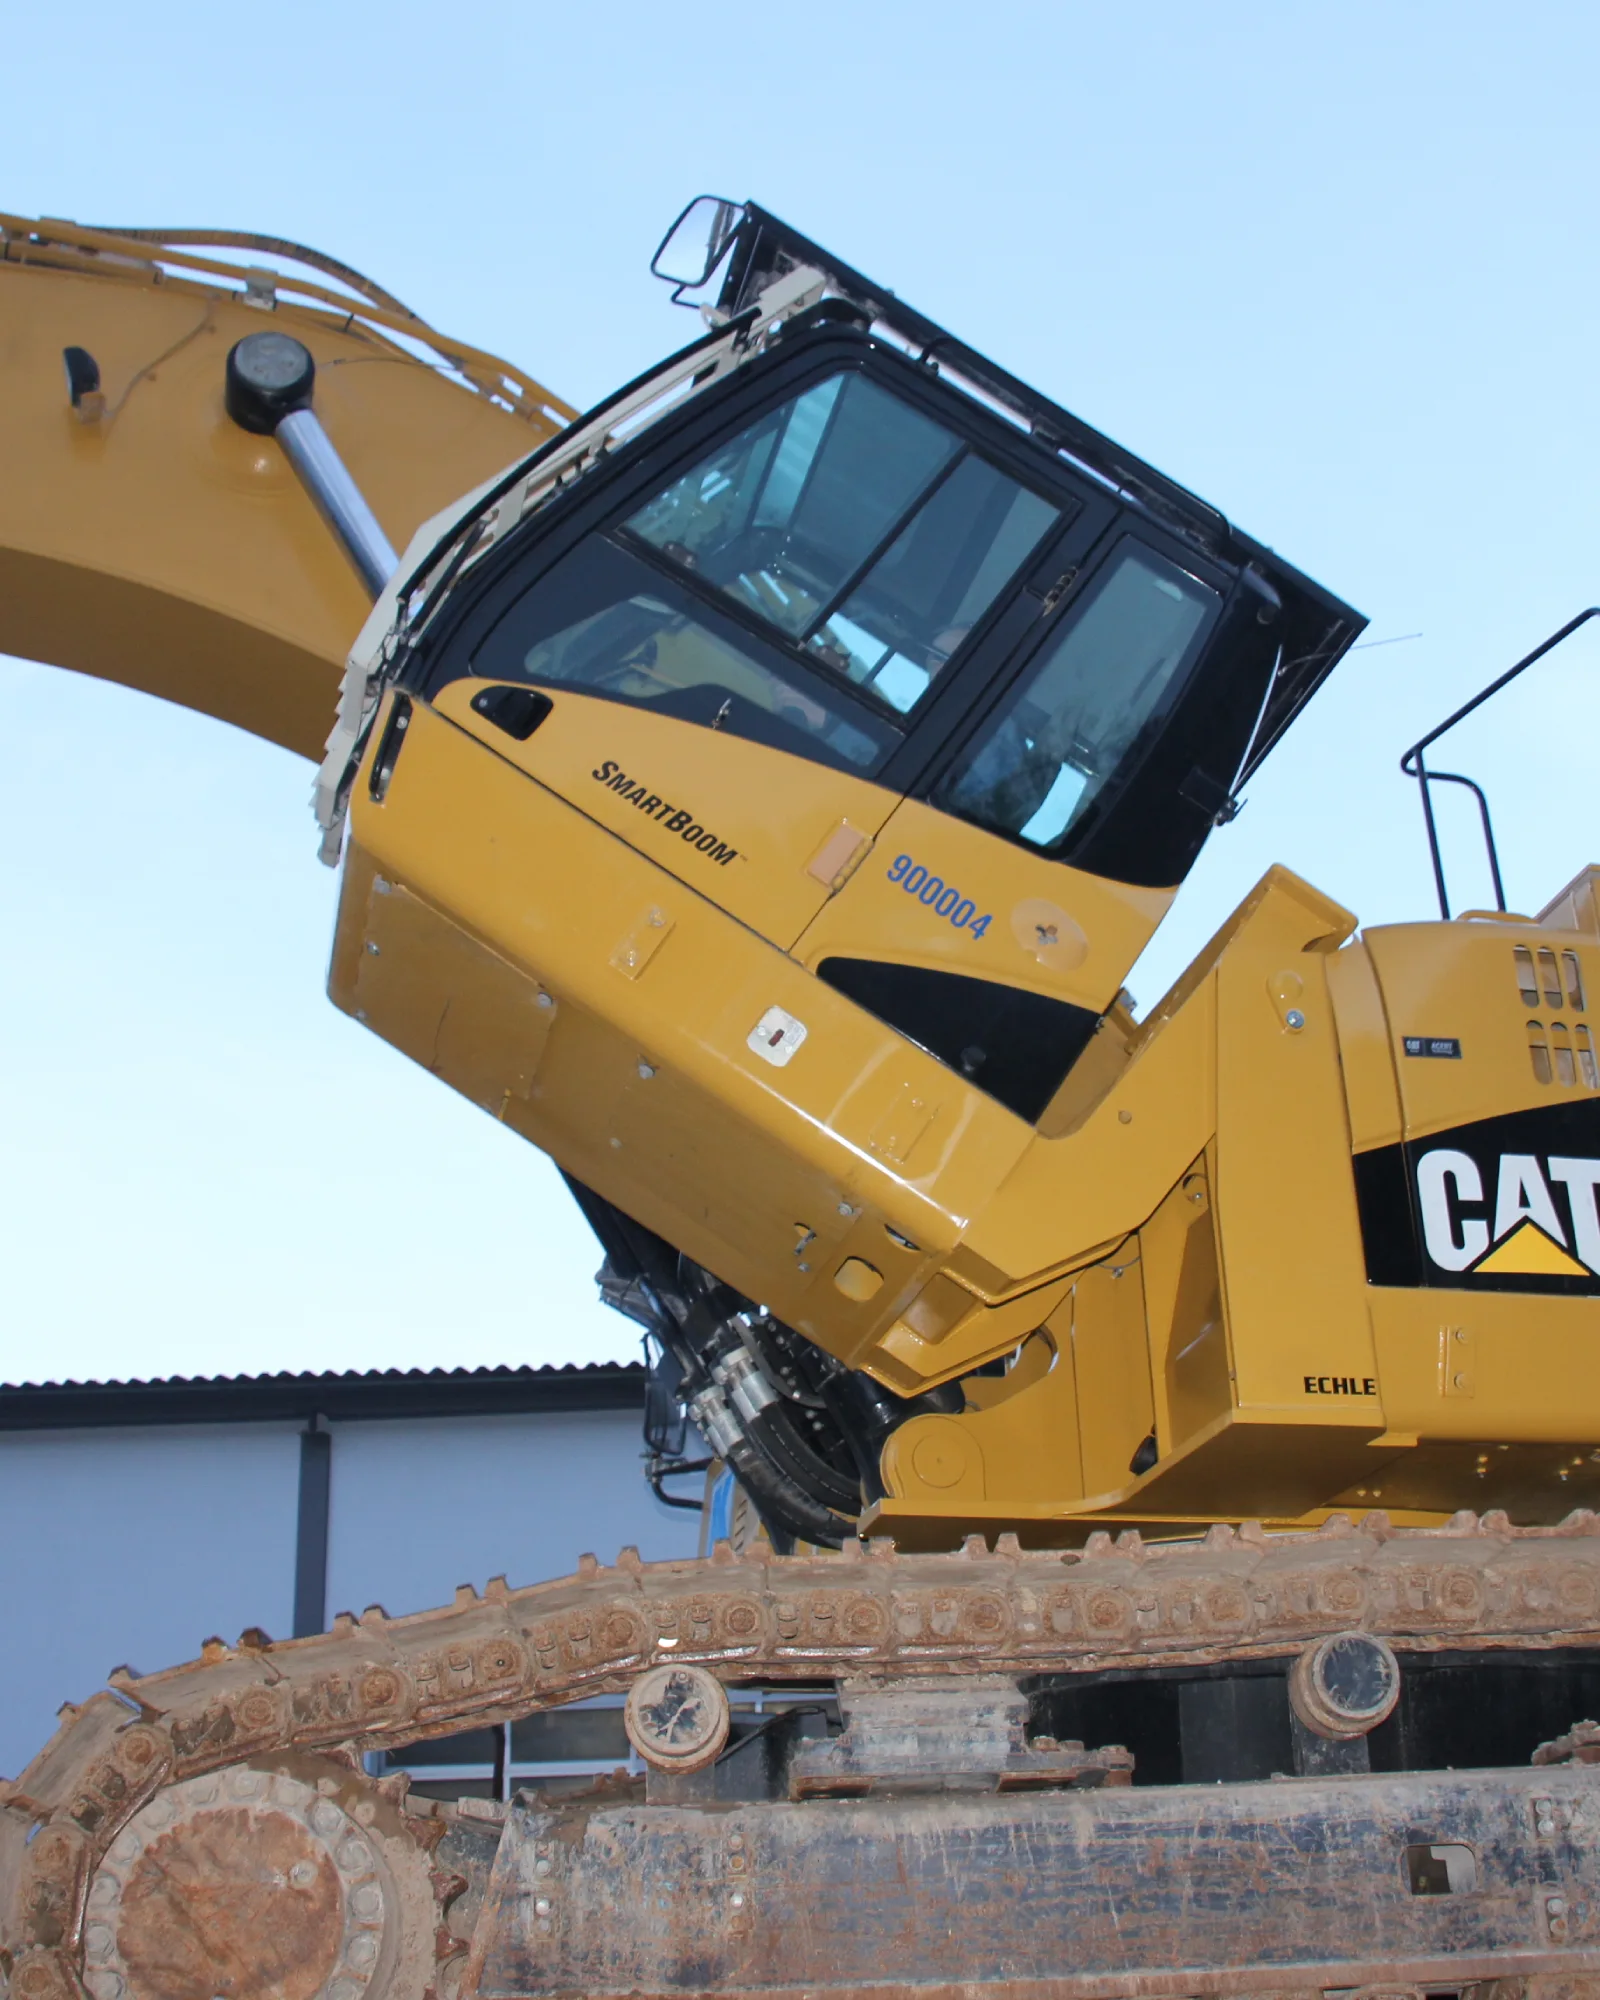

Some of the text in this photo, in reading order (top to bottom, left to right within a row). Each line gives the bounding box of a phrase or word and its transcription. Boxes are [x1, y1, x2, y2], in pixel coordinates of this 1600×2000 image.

[886, 854, 993, 940] 900004
[1417, 1149, 1600, 1277] CAT
[1304, 1376, 1377, 1396] ECHLE
